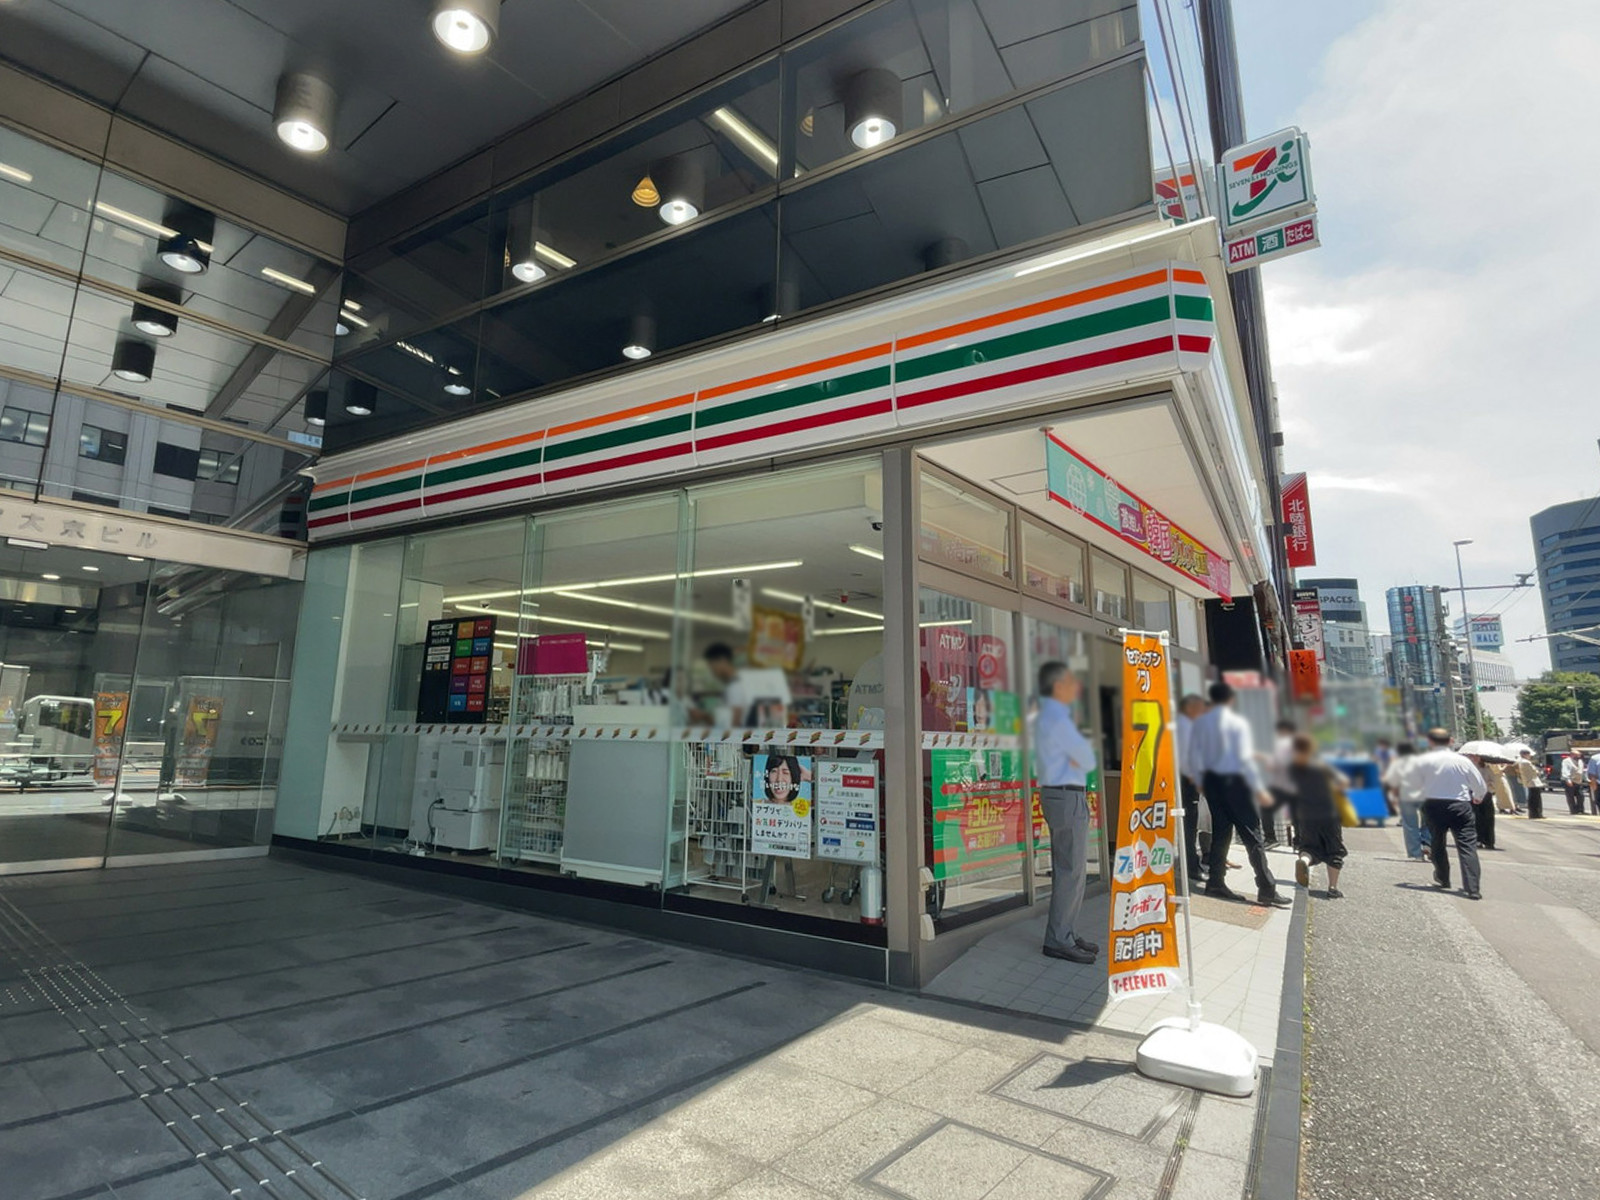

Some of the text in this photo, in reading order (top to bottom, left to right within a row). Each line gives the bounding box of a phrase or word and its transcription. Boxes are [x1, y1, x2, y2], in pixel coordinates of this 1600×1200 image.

[1229, 177, 1250, 190] SEVEN
[1260, 160, 1298, 180] HOLDINGS
[1262, 233, 1279, 252] 酒
[1286, 223, 1313, 243] たばこ
[1230, 241, 1255, 261] ATM
[940, 633, 960, 650] ATM
[1132, 700, 1163, 800] 7
[1150, 847, 1172, 866] 27日
[1114, 931, 1163, 963] 配信中
